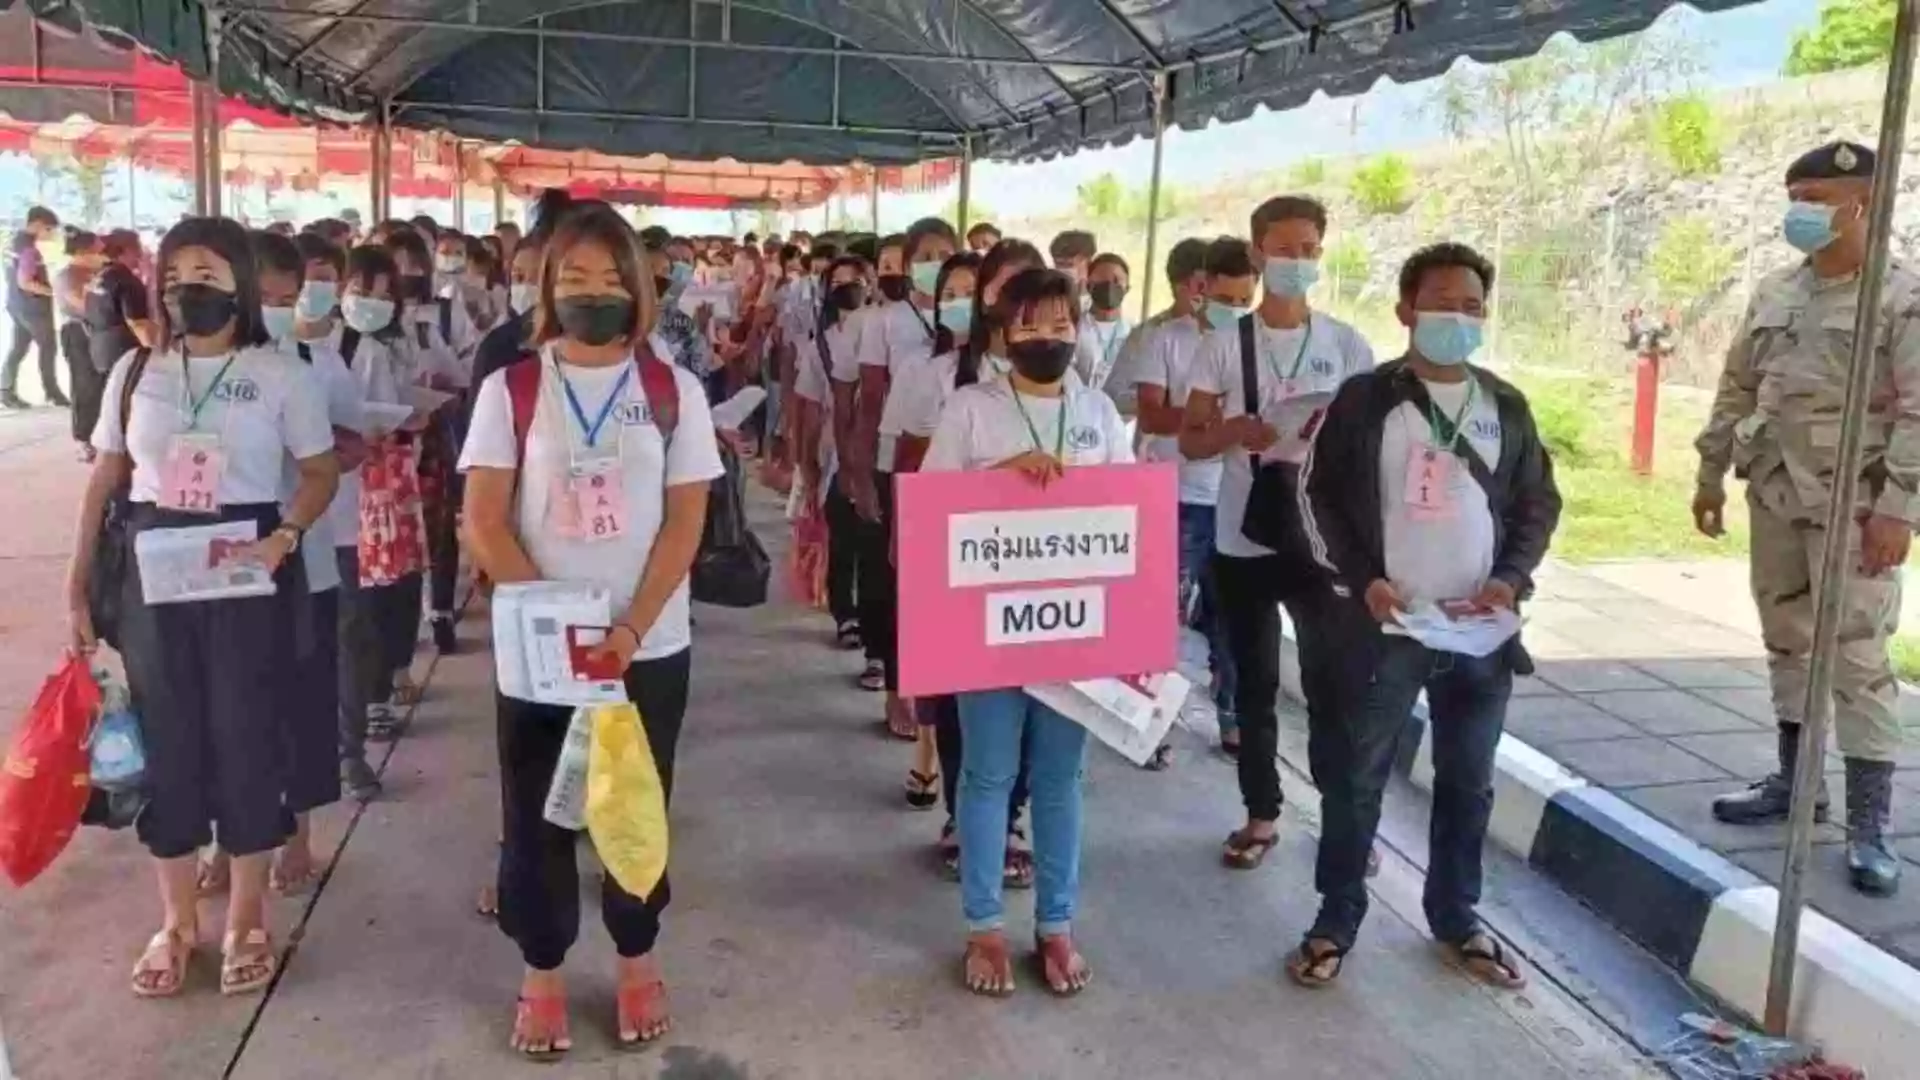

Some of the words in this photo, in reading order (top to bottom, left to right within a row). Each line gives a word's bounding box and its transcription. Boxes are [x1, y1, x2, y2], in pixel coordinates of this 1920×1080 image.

[177, 489, 213, 509] 121
[592, 513, 619, 535] 81
[959, 525, 1130, 572] กลุ่มแรงงาน
[1002, 600, 1086, 634] MOU
